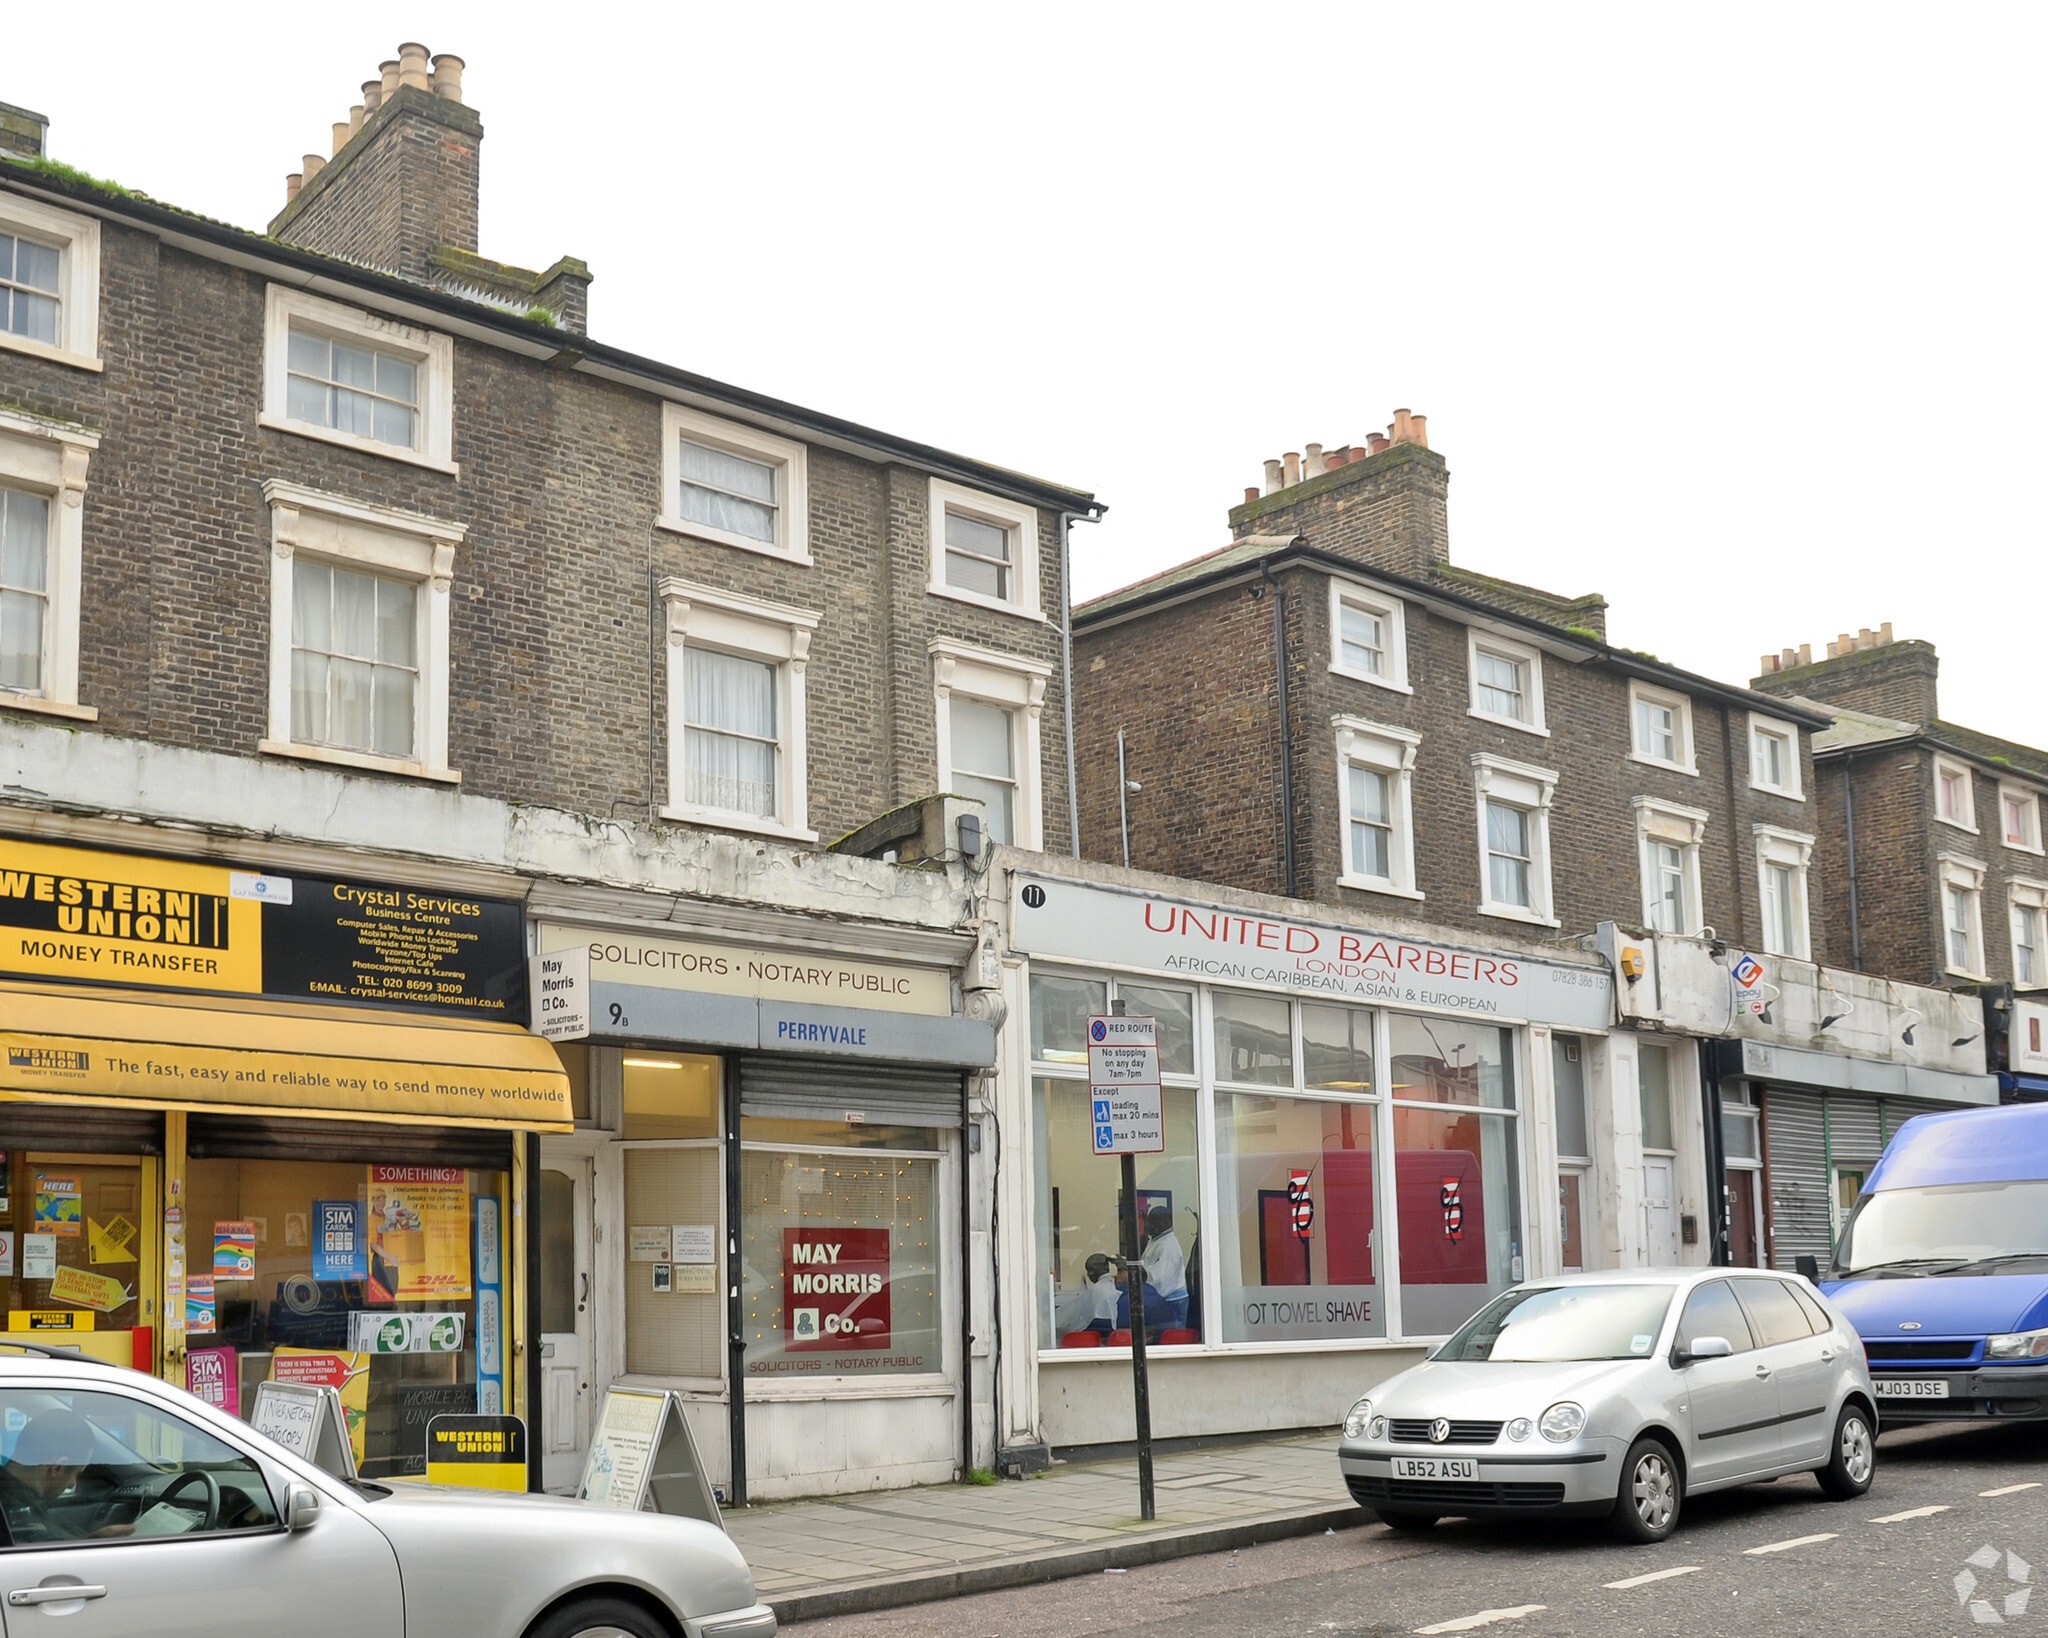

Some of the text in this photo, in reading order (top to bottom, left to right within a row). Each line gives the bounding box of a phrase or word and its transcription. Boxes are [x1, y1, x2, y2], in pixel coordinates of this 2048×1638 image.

[0, 870, 190, 918] WESTERN
[333, 884, 480, 917] Crystal Services
[1026, 886, 1041, 905] 11
[365, 906, 451, 925] Business Centre
[58, 905, 190, 944] UNION
[337, 917, 478, 941] Computer Sales, Repair & Accessories
[360, 929, 387, 939] Mobile
[389, 932, 413, 942] Phone
[358, 937, 459, 954] Worldwide Money Transfer
[1144, 902, 1519, 987] UNITED BARBERS
[21, 940, 218, 974] MONEY TRANSFER
[385, 956, 414, 966] Internet
[428, 953, 443, 961] Ups
[423, 968, 430, 976] &
[432, 969, 465, 980] Scanning
[542, 960, 563, 974] May
[589, 943, 911, 995] SOLICITORS NOTARY PUBLIC
[1296, 957, 1397, 984] LONDON
[357, 975, 463, 994] TEL: 020 8699 3009
[542, 976, 574, 992] Morris
[1164, 953, 1497, 1012] AFRICAN CARIBBEAN, ASIAN & EUROPEAN
[1551, 969, 1609, 990] 07828 386 157
[1736, 989, 1761, 999] epay
[552, 996, 568, 1010] Co.
[541, 1024, 584, 1036] NOTARY PUBLIC
[778, 1020, 867, 1046] PERRYVALE
[1109, 1024, 1153, 1033] RED ROUTE
[9, 1048, 78, 1061] WESTERN
[1102, 1048, 1147, 1059] No stopping
[31, 1057, 78, 1069] UNION
[1104, 1059, 1145, 1069] on any day
[105, 1057, 565, 1103] The fast, easy and reliable way to send money worldwide
[1108, 1069, 1142, 1079] 7am-7pm
[1093, 1087, 1119, 1096] Except
[1111, 1101, 1139, 1111] loading
[1112, 1111, 1159, 1120] max 20 mins
[1113, 1130, 1159, 1139] max 3 hours
[379, 1166, 457, 1181] SOMETHING?
[43, 1181, 75, 1191] HERE
[325, 1211, 354, 1224] SIM
[325, 1254, 354, 1265] HERE
[792, 1243, 842, 1265] MAY
[416, 1275, 458, 1285] DHL
[793, 1273, 882, 1294] MORRIS
[1273, 1301, 1371, 1324] TOWEL SHAVE
[797, 1312, 860, 1335] & Co.
[192, 1361, 222, 1377] SIM
[749, 1356, 923, 1372] SOLICITORS NOTARY PUBLIC
[1875, 1383, 1942, 1395] MJ03 DSE
[436, 1431, 502, 1442] WESTERN
[457, 1442, 502, 1453] UNION
[1397, 1461, 1472, 1478] LB52 ASU
